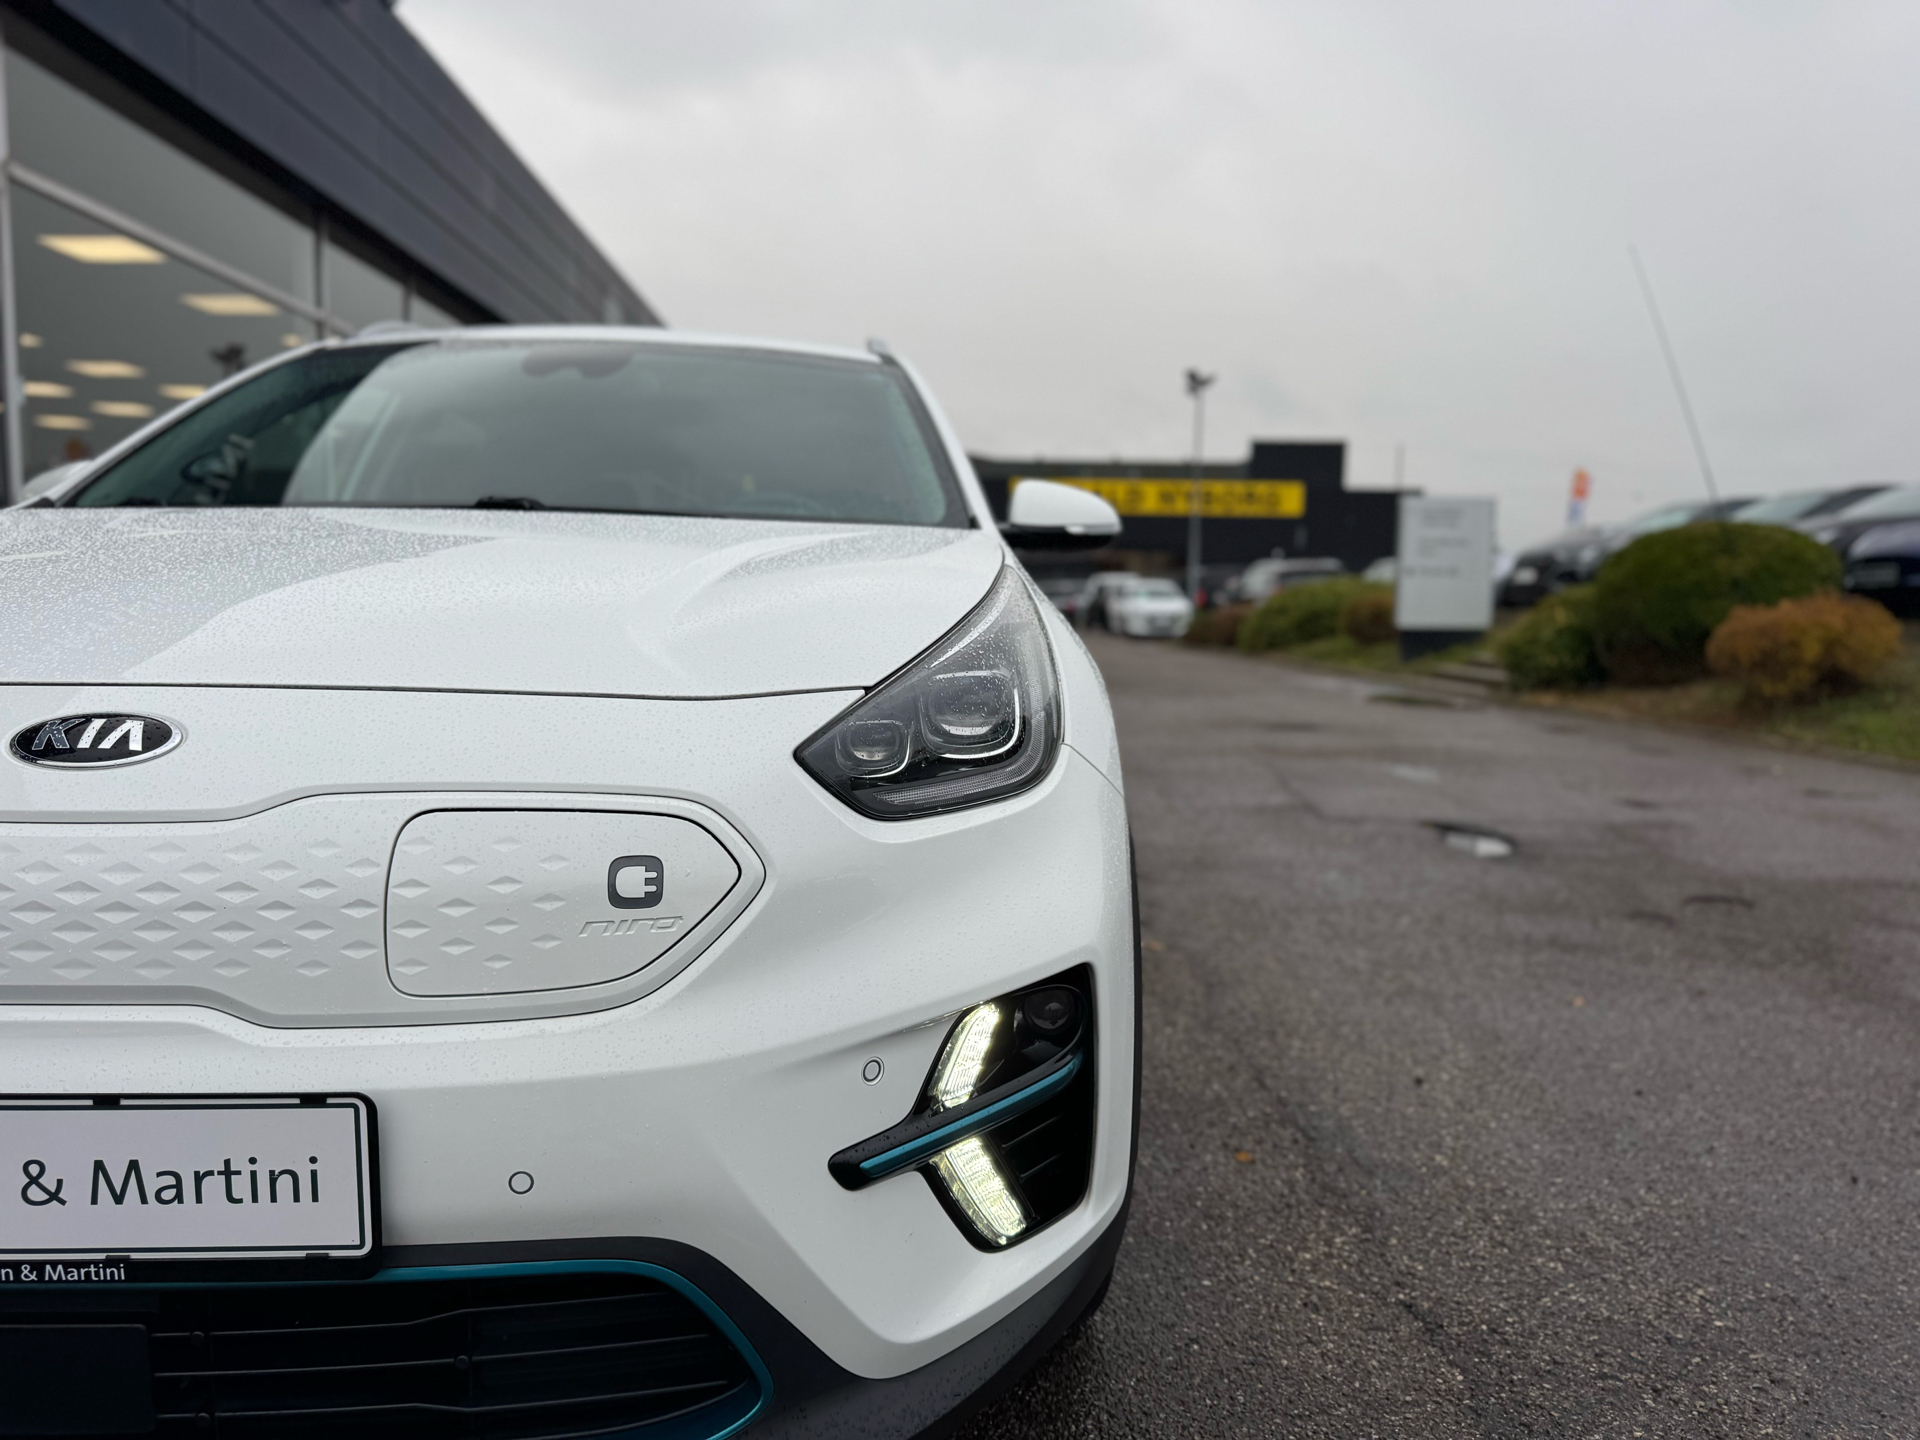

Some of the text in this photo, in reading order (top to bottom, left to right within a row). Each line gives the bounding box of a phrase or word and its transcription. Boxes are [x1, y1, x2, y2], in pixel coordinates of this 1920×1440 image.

[31, 718, 145, 752] KIA
[20, 1155, 320, 1207] & Martini
[20, 1263, 38, 1281] &
[44, 1263, 126, 1281] Martini
